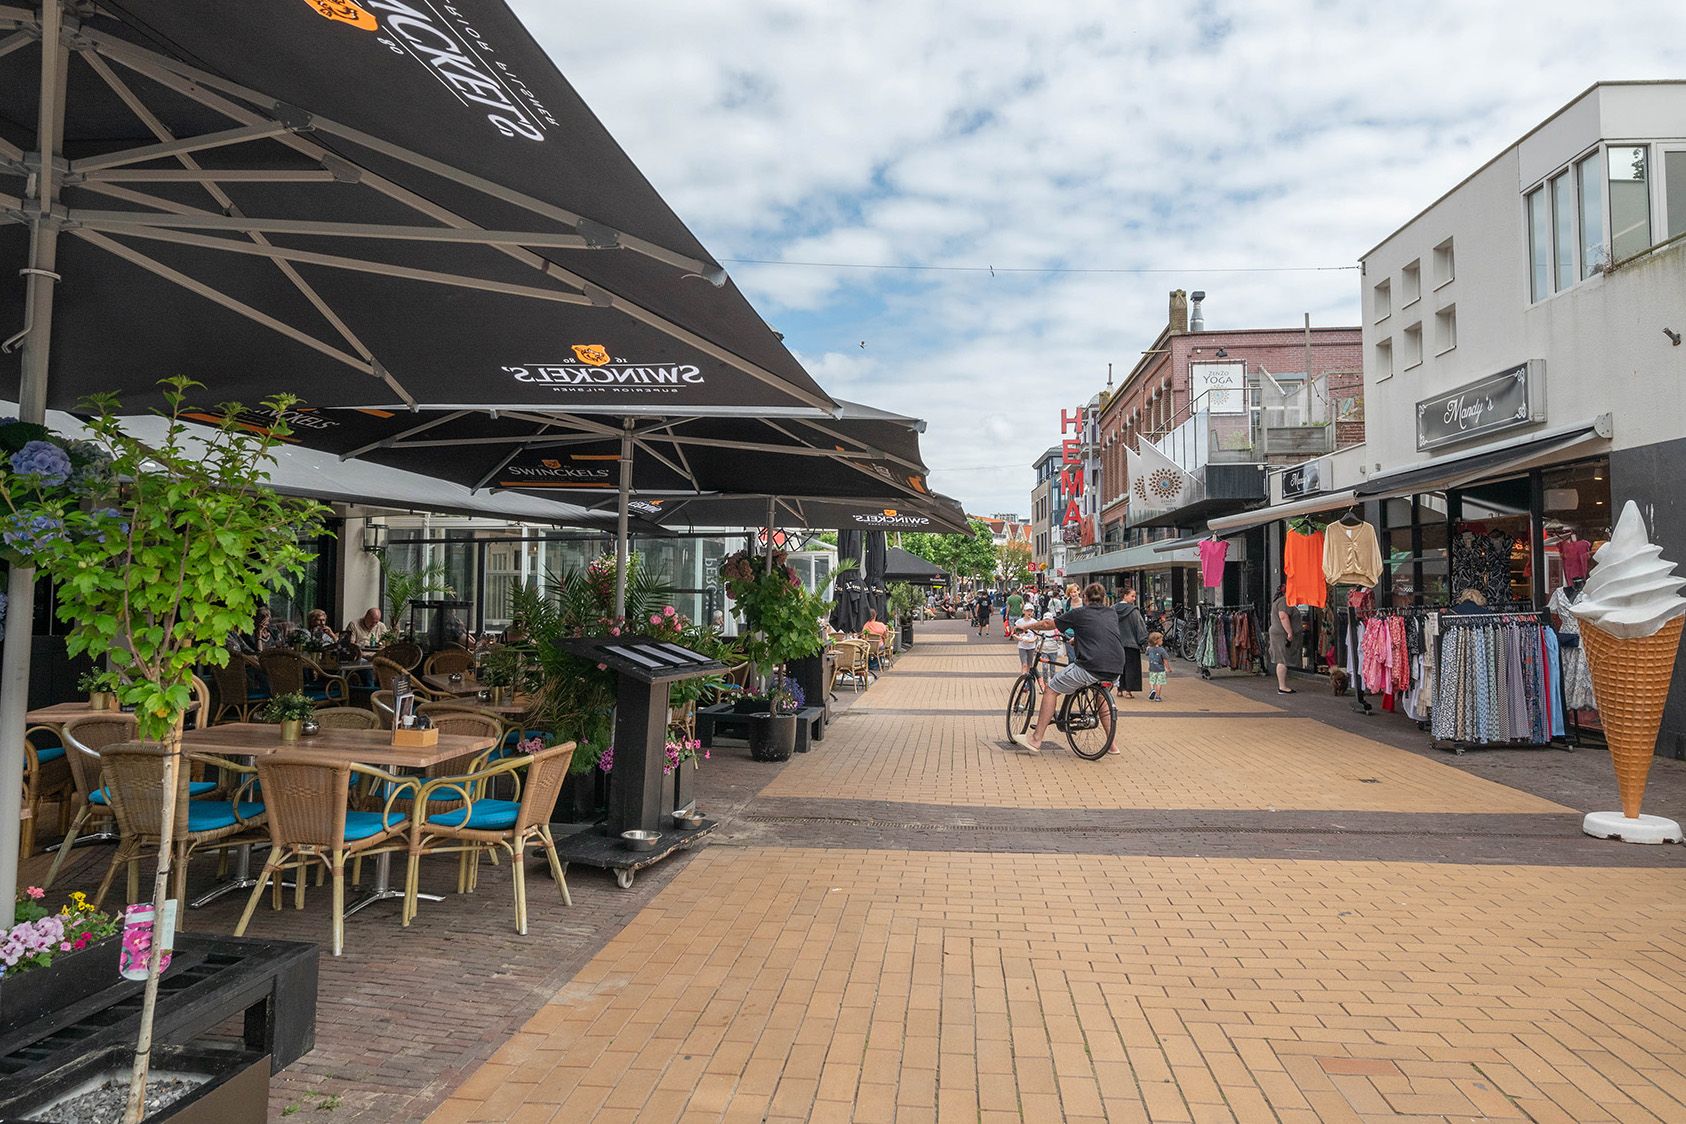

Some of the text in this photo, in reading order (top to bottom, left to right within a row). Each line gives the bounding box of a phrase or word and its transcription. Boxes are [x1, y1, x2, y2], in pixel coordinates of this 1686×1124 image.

[1203, 375, 1234, 384] YOGA
[508, 464, 610, 478] SWINCKELS'
[1060, 406, 1085, 527] HEMA
